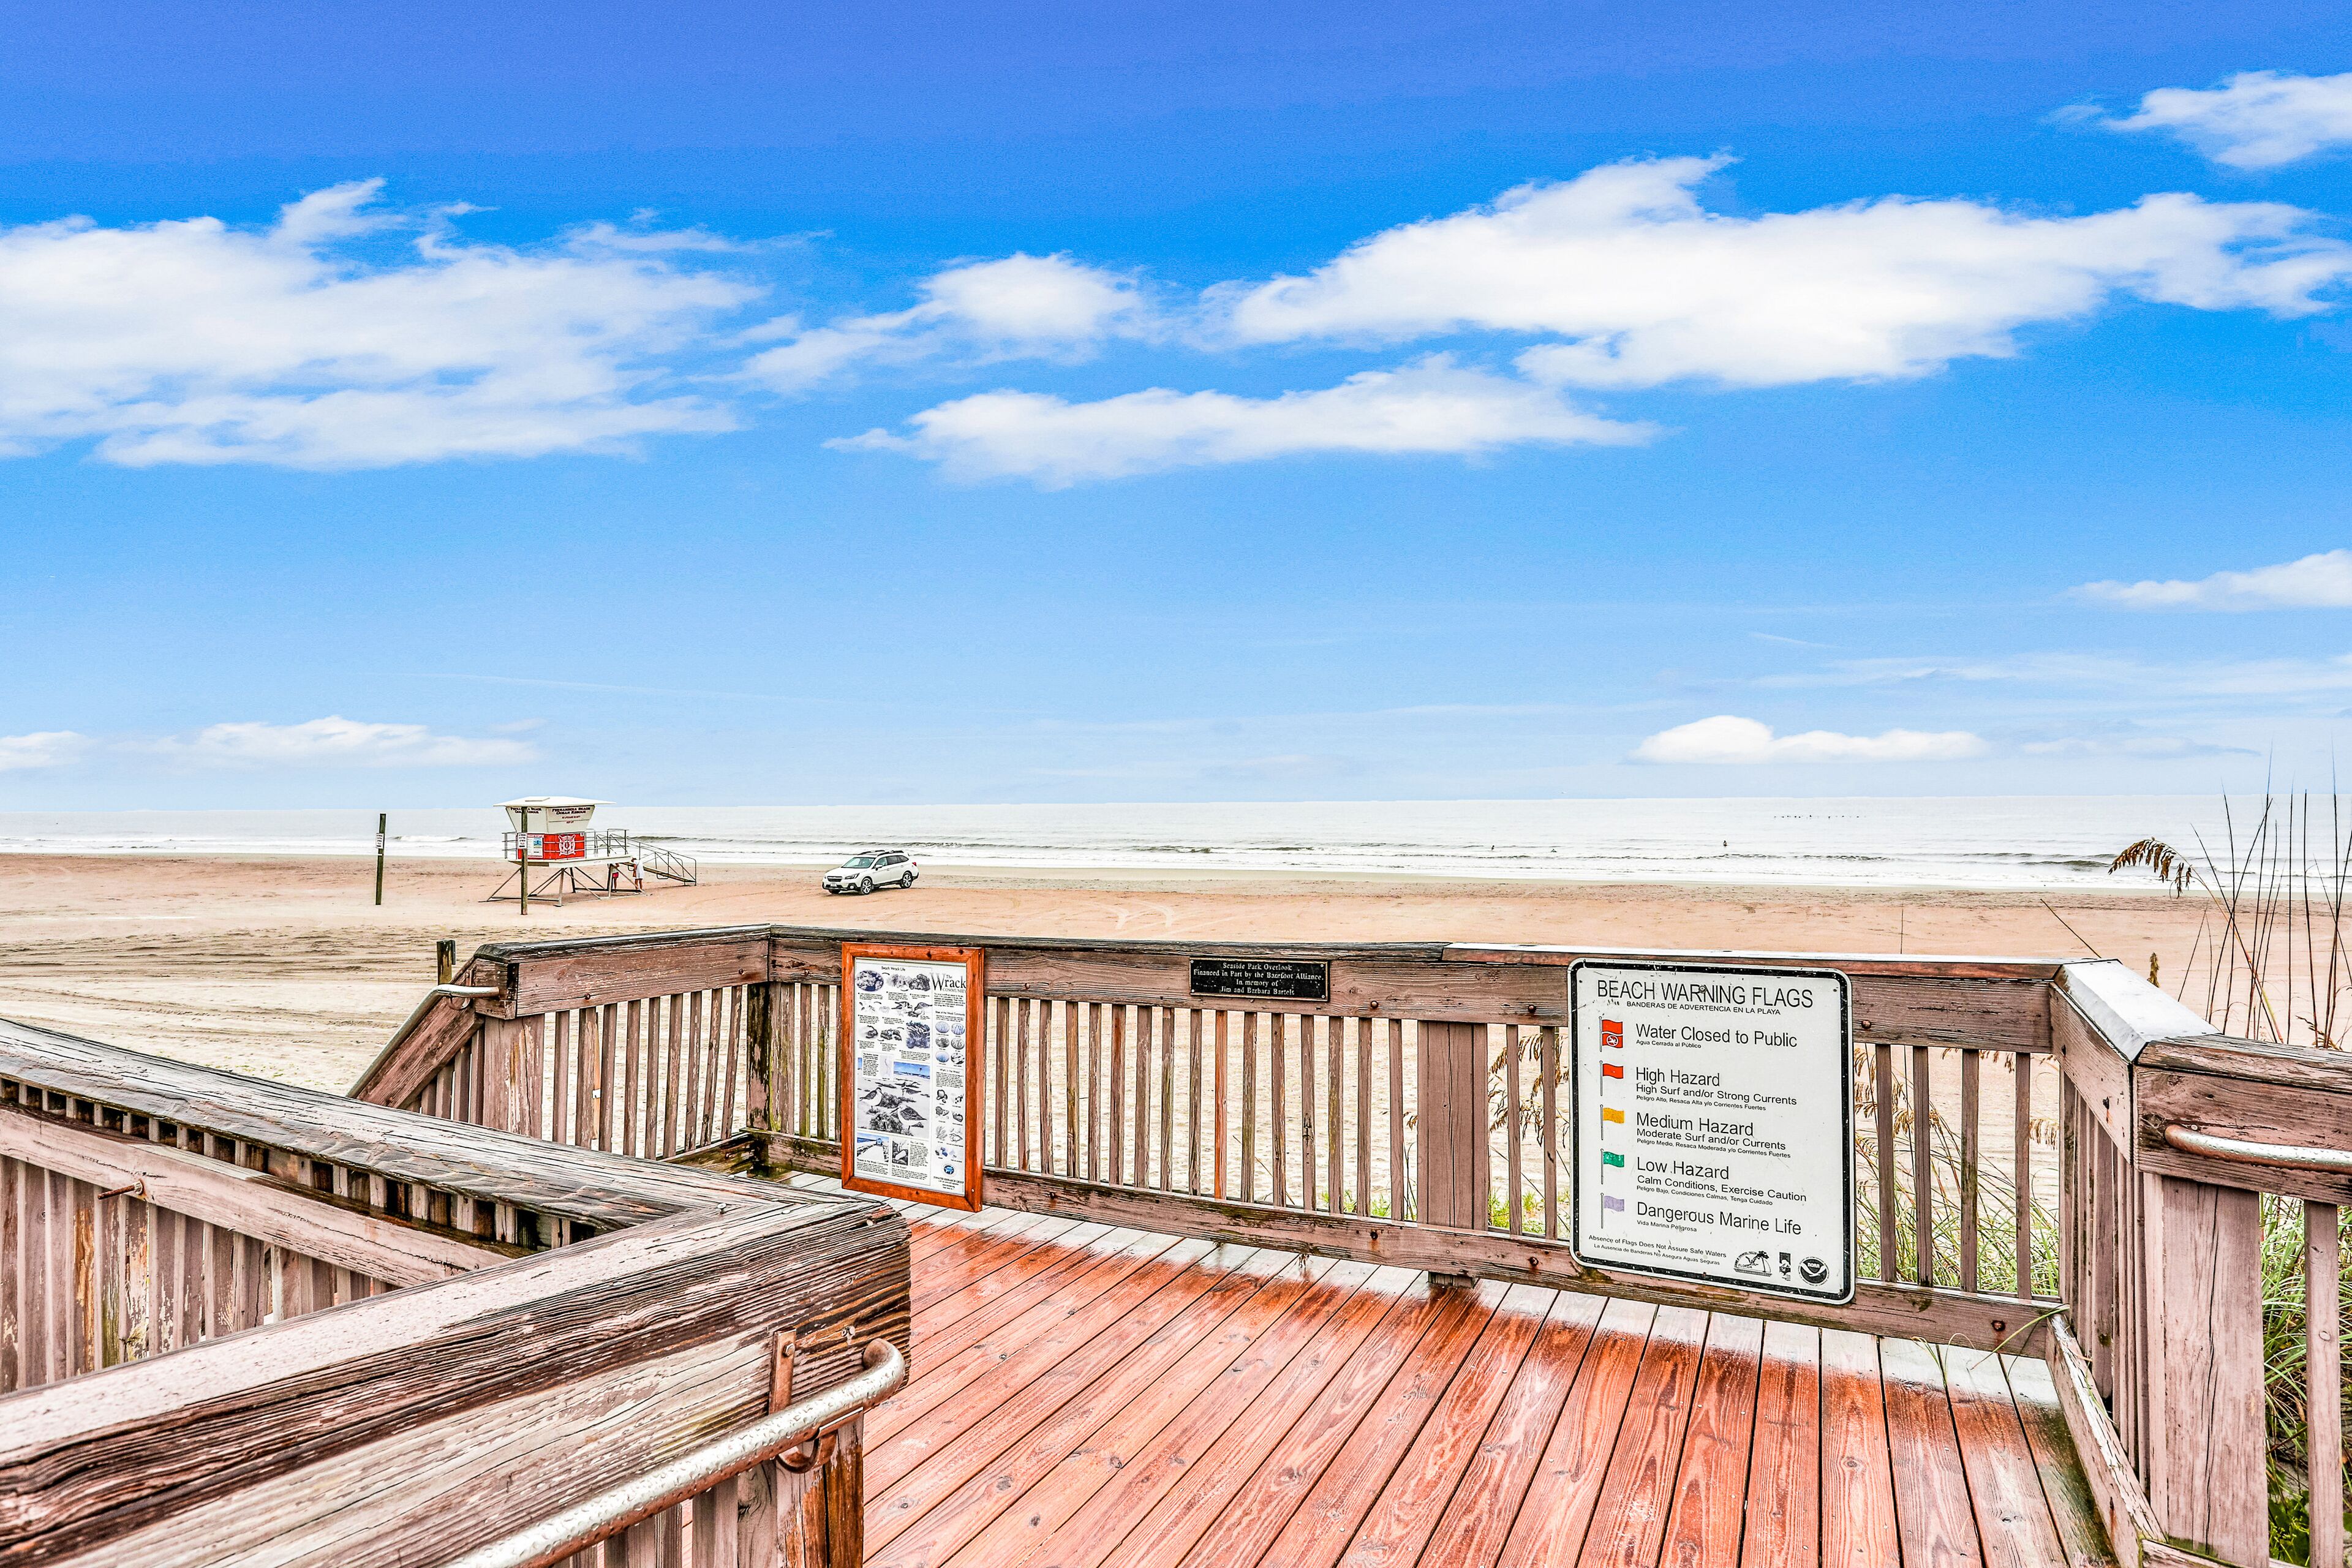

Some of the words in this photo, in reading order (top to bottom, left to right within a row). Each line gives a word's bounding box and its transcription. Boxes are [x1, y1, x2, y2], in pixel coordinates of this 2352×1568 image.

[929, 972, 967, 991] Wrack
[1597, 980, 1655, 1000] BEACH
[1661, 982, 1746, 1005] WARNING
[1752, 987, 1813, 1008] FLAGS
[1636, 1023, 1676, 1039] Water
[1681, 1026, 1730, 1043] Closed
[1735, 1030, 1749, 1044] to
[1754, 1031, 1797, 1047] Public
[1636, 1066, 1665, 1085] High
[1670, 1069, 1720, 1087] Hazard
[1636, 1084, 1657, 1095] High
[1660, 1086, 1681, 1095] Surf
[1683, 1089, 1714, 1098] and/or
[1717, 1091, 1750, 1102] Strong
[1754, 1093, 1797, 1105] Currents
[1637, 1112, 1692, 1130] Medium
[1699, 1117, 1753, 1136] Hazard
[1637, 1128, 1681, 1140] Moderate
[1685, 1133, 1705, 1142] Surf
[1708, 1136, 1740, 1145] and/or
[1743, 1138, 1786, 1150] Currents
[1637, 1156, 1667, 1173] Low
[1673, 1161, 1729, 1180] Hazard
[1637, 1175, 1661, 1185] Calm
[1665, 1178, 1717, 1193] Conditions,
[1721, 1185, 1764, 1197] Exercise
[1768, 1189, 1806, 1202] Caution
[1637, 1201, 1714, 1224] Dangerous
[1720, 1211, 1770, 1231] Marine
[1775, 1218, 1801, 1235] Life
[1705, 1250, 1727, 1258] Waters
